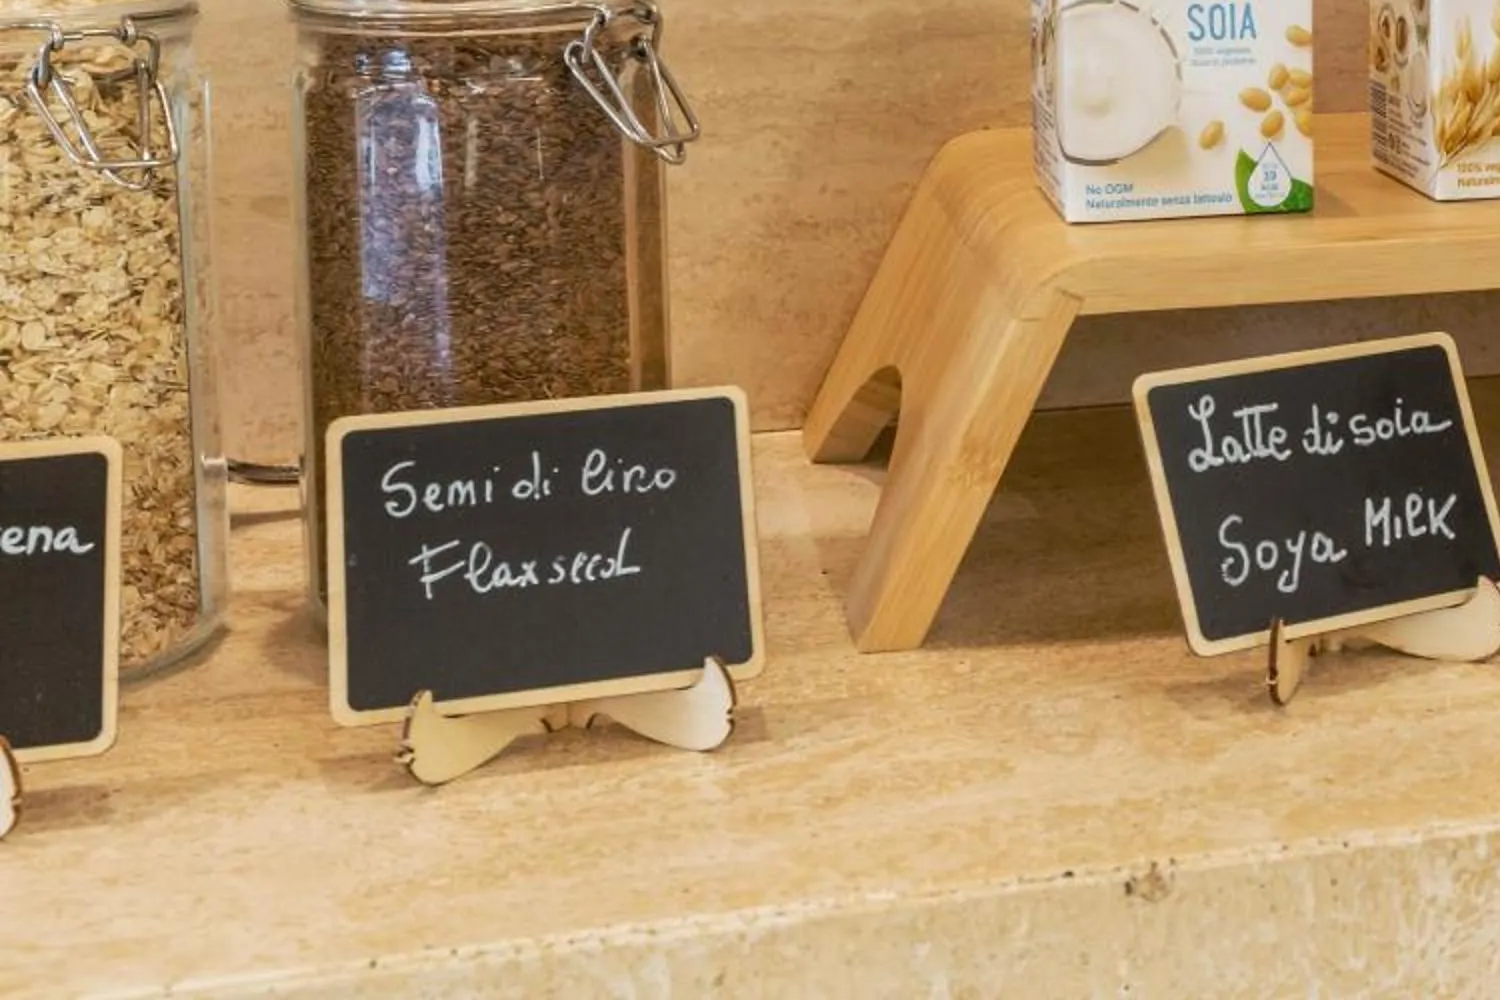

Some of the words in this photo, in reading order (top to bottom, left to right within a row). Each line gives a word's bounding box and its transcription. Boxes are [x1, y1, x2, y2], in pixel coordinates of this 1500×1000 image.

[1187, 1, 1257, 41] SOIA
[1187, 394, 1293, 473] Latte
[1302, 403, 1345, 456] di
[1349, 397, 1453, 445] soia
[380, 460, 501, 518] Semi
[511, 450, 560, 501] di
[0, 525, 96, 557] ena
[1218, 514, 1348, 593] Soya
